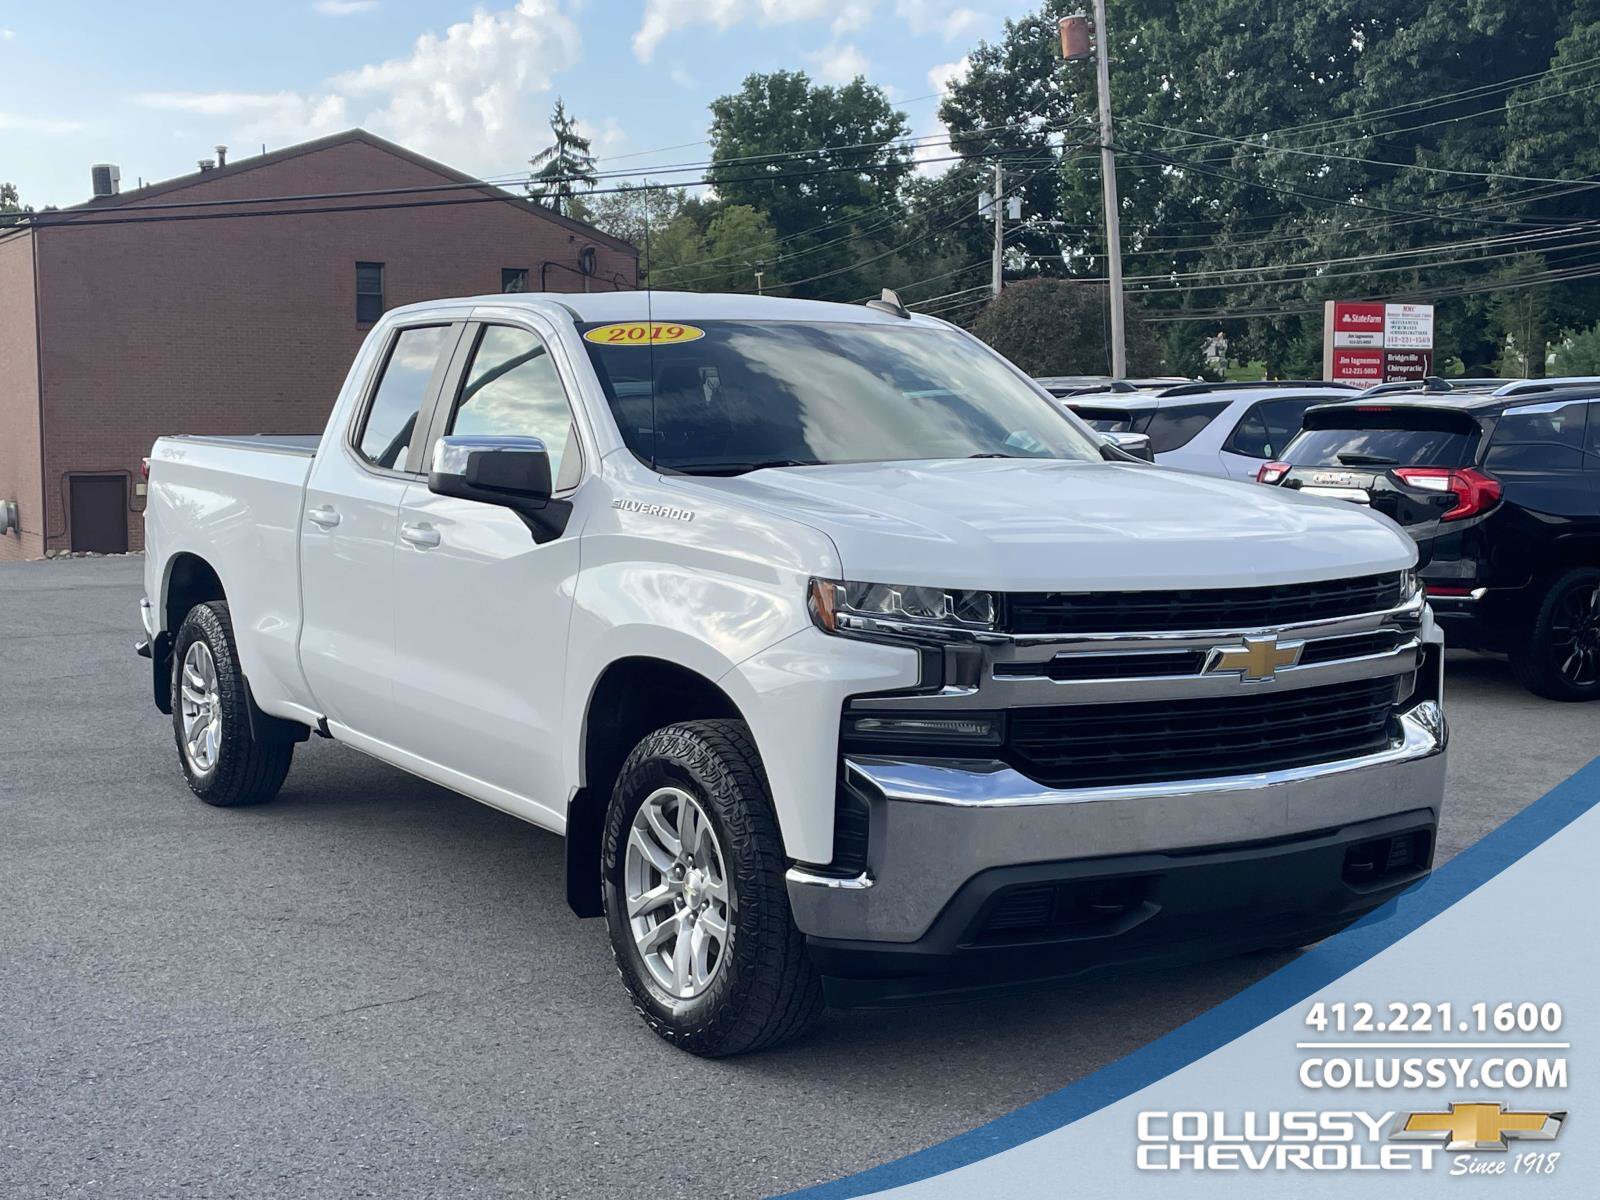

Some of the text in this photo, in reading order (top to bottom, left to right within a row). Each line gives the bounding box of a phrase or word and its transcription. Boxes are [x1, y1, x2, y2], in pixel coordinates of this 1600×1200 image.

[607, 326, 686, 342] 2019
[1339, 357, 1351, 365] Jim
[1387, 354, 1419, 363] Bridgeville
[1387, 364, 1423, 373] Chiropractic
[610, 499, 696, 522] SILVERADO
